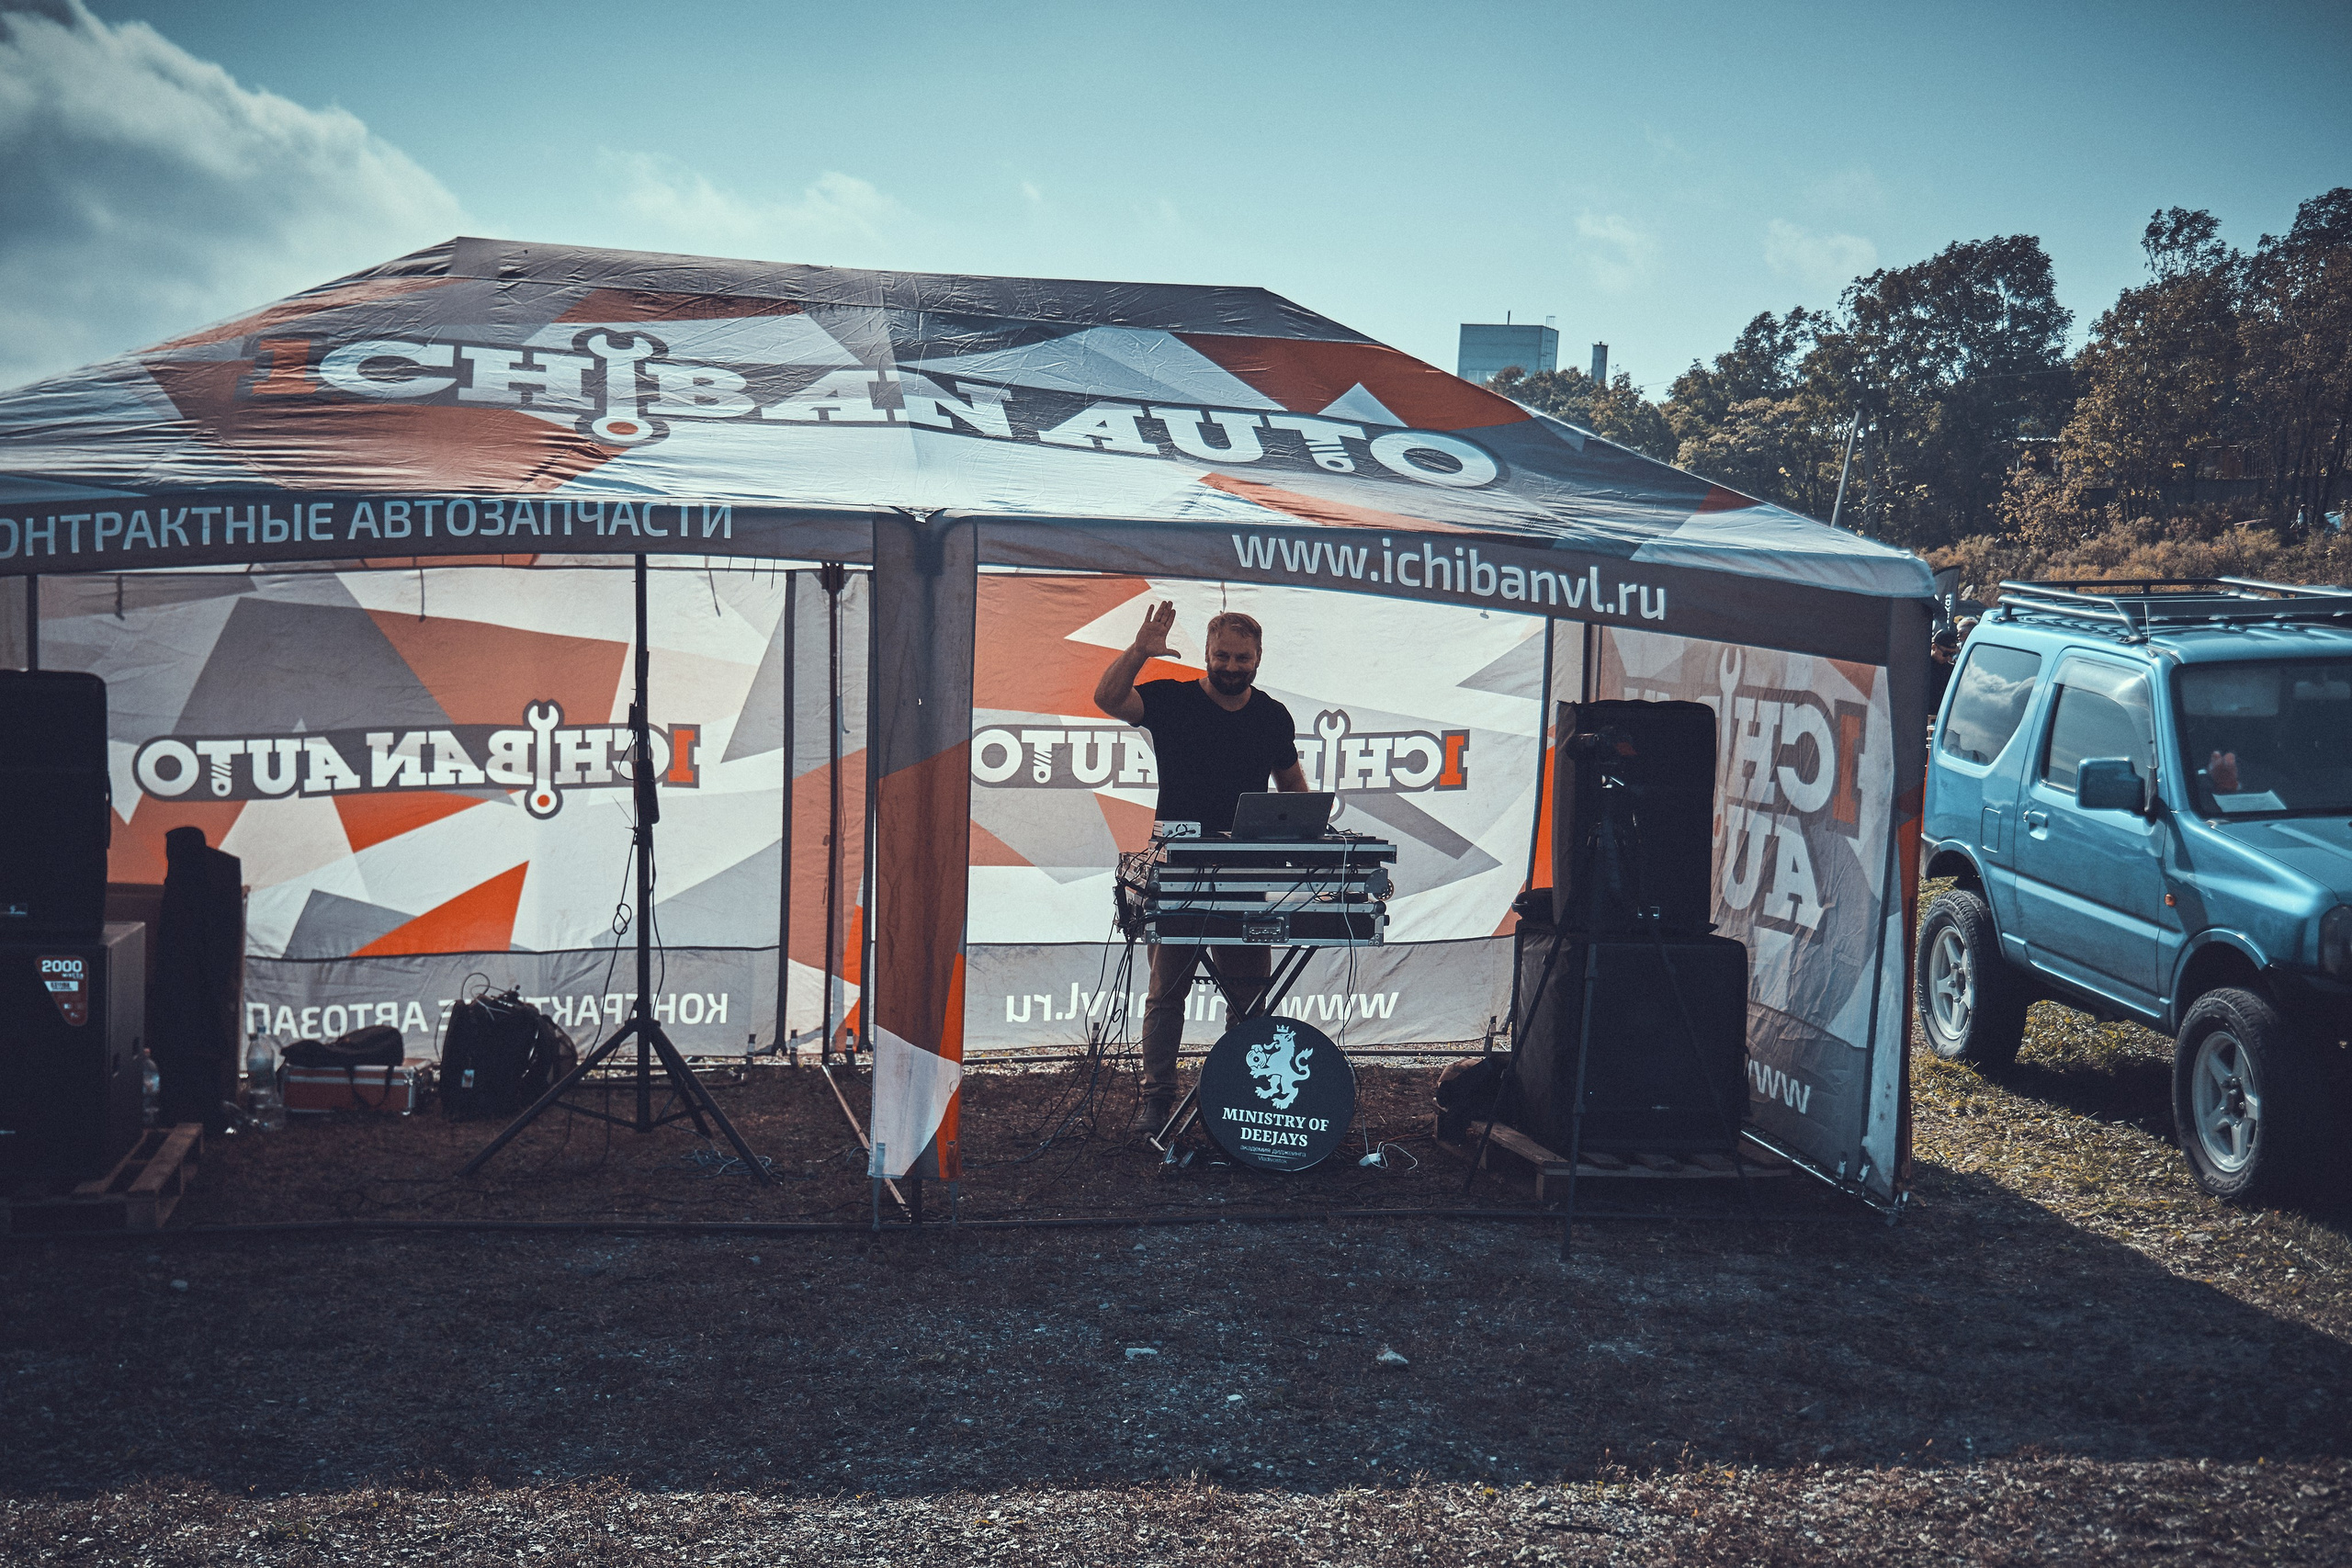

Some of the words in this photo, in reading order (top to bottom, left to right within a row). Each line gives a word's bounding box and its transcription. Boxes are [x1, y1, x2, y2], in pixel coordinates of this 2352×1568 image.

[1038, 404, 1499, 488] AUTO
[0, 502, 334, 558] ОНТРАКТНЫЕ
[347, 499, 732, 538] АВТОЗАПЧАСТИ
[1231, 534, 1666, 621] www.ichibanvl.ru
[41, 959, 83, 973] 2000
[1222, 1107, 1306, 1129] MINISTRY
[1308, 1118, 1329, 1132] OF
[1240, 1127, 1308, 1147] DEEJAYS
